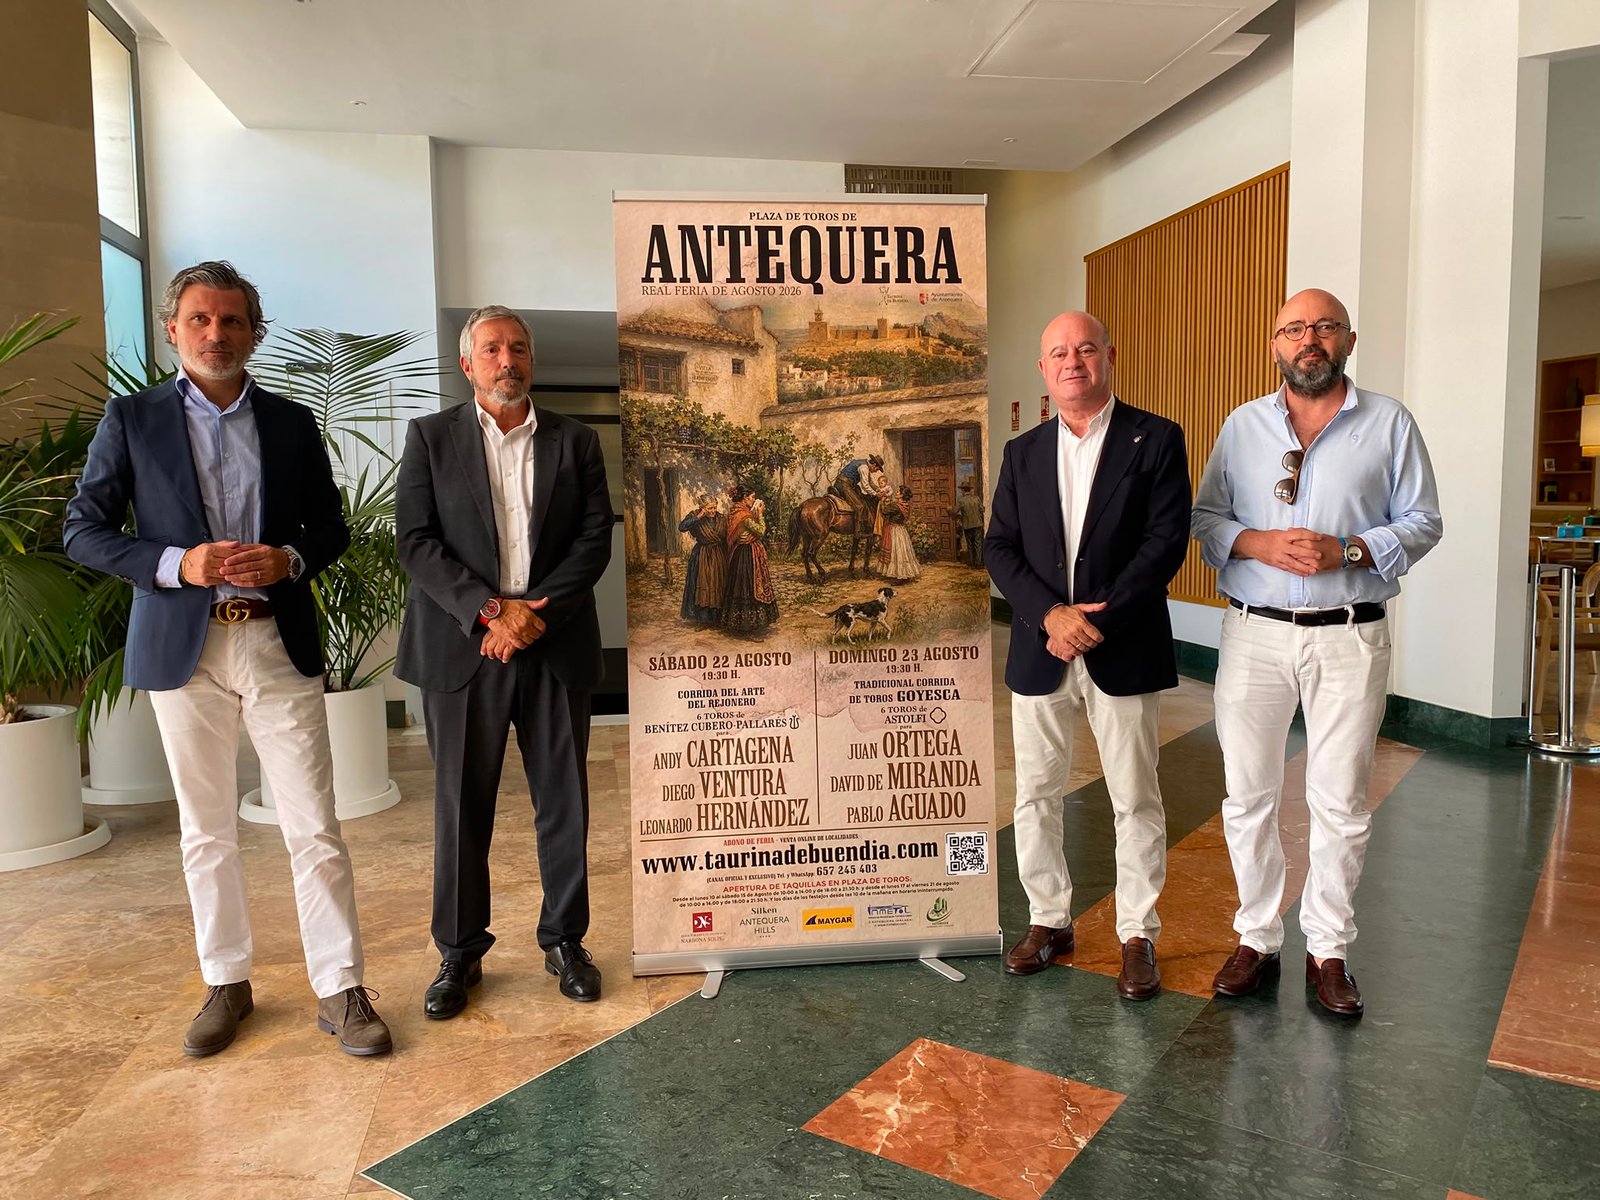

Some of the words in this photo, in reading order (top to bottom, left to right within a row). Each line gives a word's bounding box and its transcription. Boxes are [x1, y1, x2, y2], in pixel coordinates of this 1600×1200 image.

[749, 212, 782, 220] PLAZA
[786, 212, 800, 220] DE
[803, 212, 839, 221] TOROS
[641, 224, 962, 294] ANTEQUERA
[642, 286, 671, 296] REAL
[675, 286, 708, 296] FERIA
[712, 286, 728, 296] DE
[731, 286, 776, 296] AGOSTO
[779, 286, 802, 296] 2026
[649, 653, 707, 671] SÁBADO
[713, 655, 729, 668] 22
[735, 652, 792, 667] AGOSTO
[829, 649, 897, 664] DOMINGO
[902, 649, 918, 662] 23
[923, 646, 979, 661] AGOSTO
[702, 671, 727, 680] 19:30
[731, 670, 740, 679] H.
[886, 665, 910, 674] 19:30
[914, 664, 923, 672] H.
[854, 679, 914, 689] TRADICIONAL
[916, 678, 955, 686] CORRIDA
[678, 689, 718, 699] CORRIDA
[721, 688, 739, 697] DEL
[742, 687, 765, 696] ARTE
[850, 696, 861, 704] DE
[864, 694, 893, 702] TOROS
[897, 689, 960, 702] GOYESCA
[688, 700, 705, 709] DEL
[708, 698, 756, 708] REJONERO
[645, 722, 689, 734] BENÍTEZ
[692, 717, 787, 731] CUBERO-PALLARÉS
[884, 714, 927, 724] ASTOLFI
[848, 742, 878, 760] JUAN
[883, 729, 962, 758] ORTEGA
[653, 752, 682, 770] ANDY
[687, 736, 794, 767] CARTAGENA
[831, 775, 864, 792] DAVID
[867, 774, 883, 791] DE
[888, 760, 982, 790] MIRANDA
[662, 784, 695, 801] DIEGO
[699, 768, 786, 798] VENTURA
[847, 806, 883, 823] PABLO
[888, 791, 966, 822] AGUADO
[640, 818, 692, 835] LEONARDO
[696, 797, 810, 831] HERNÁNDEZ
[642, 840, 938, 874] www.taurinadebuendia.com
[816, 866, 834, 876] 657
[838, 865, 856, 874] 245
[860, 864, 877, 873] 403
[723, 884, 767, 892] APERTURA
[782, 881, 826, 889] TAQUILLAS
[740, 916, 789, 926] ANTEQUERA
[754, 926, 775, 934] HILLS
